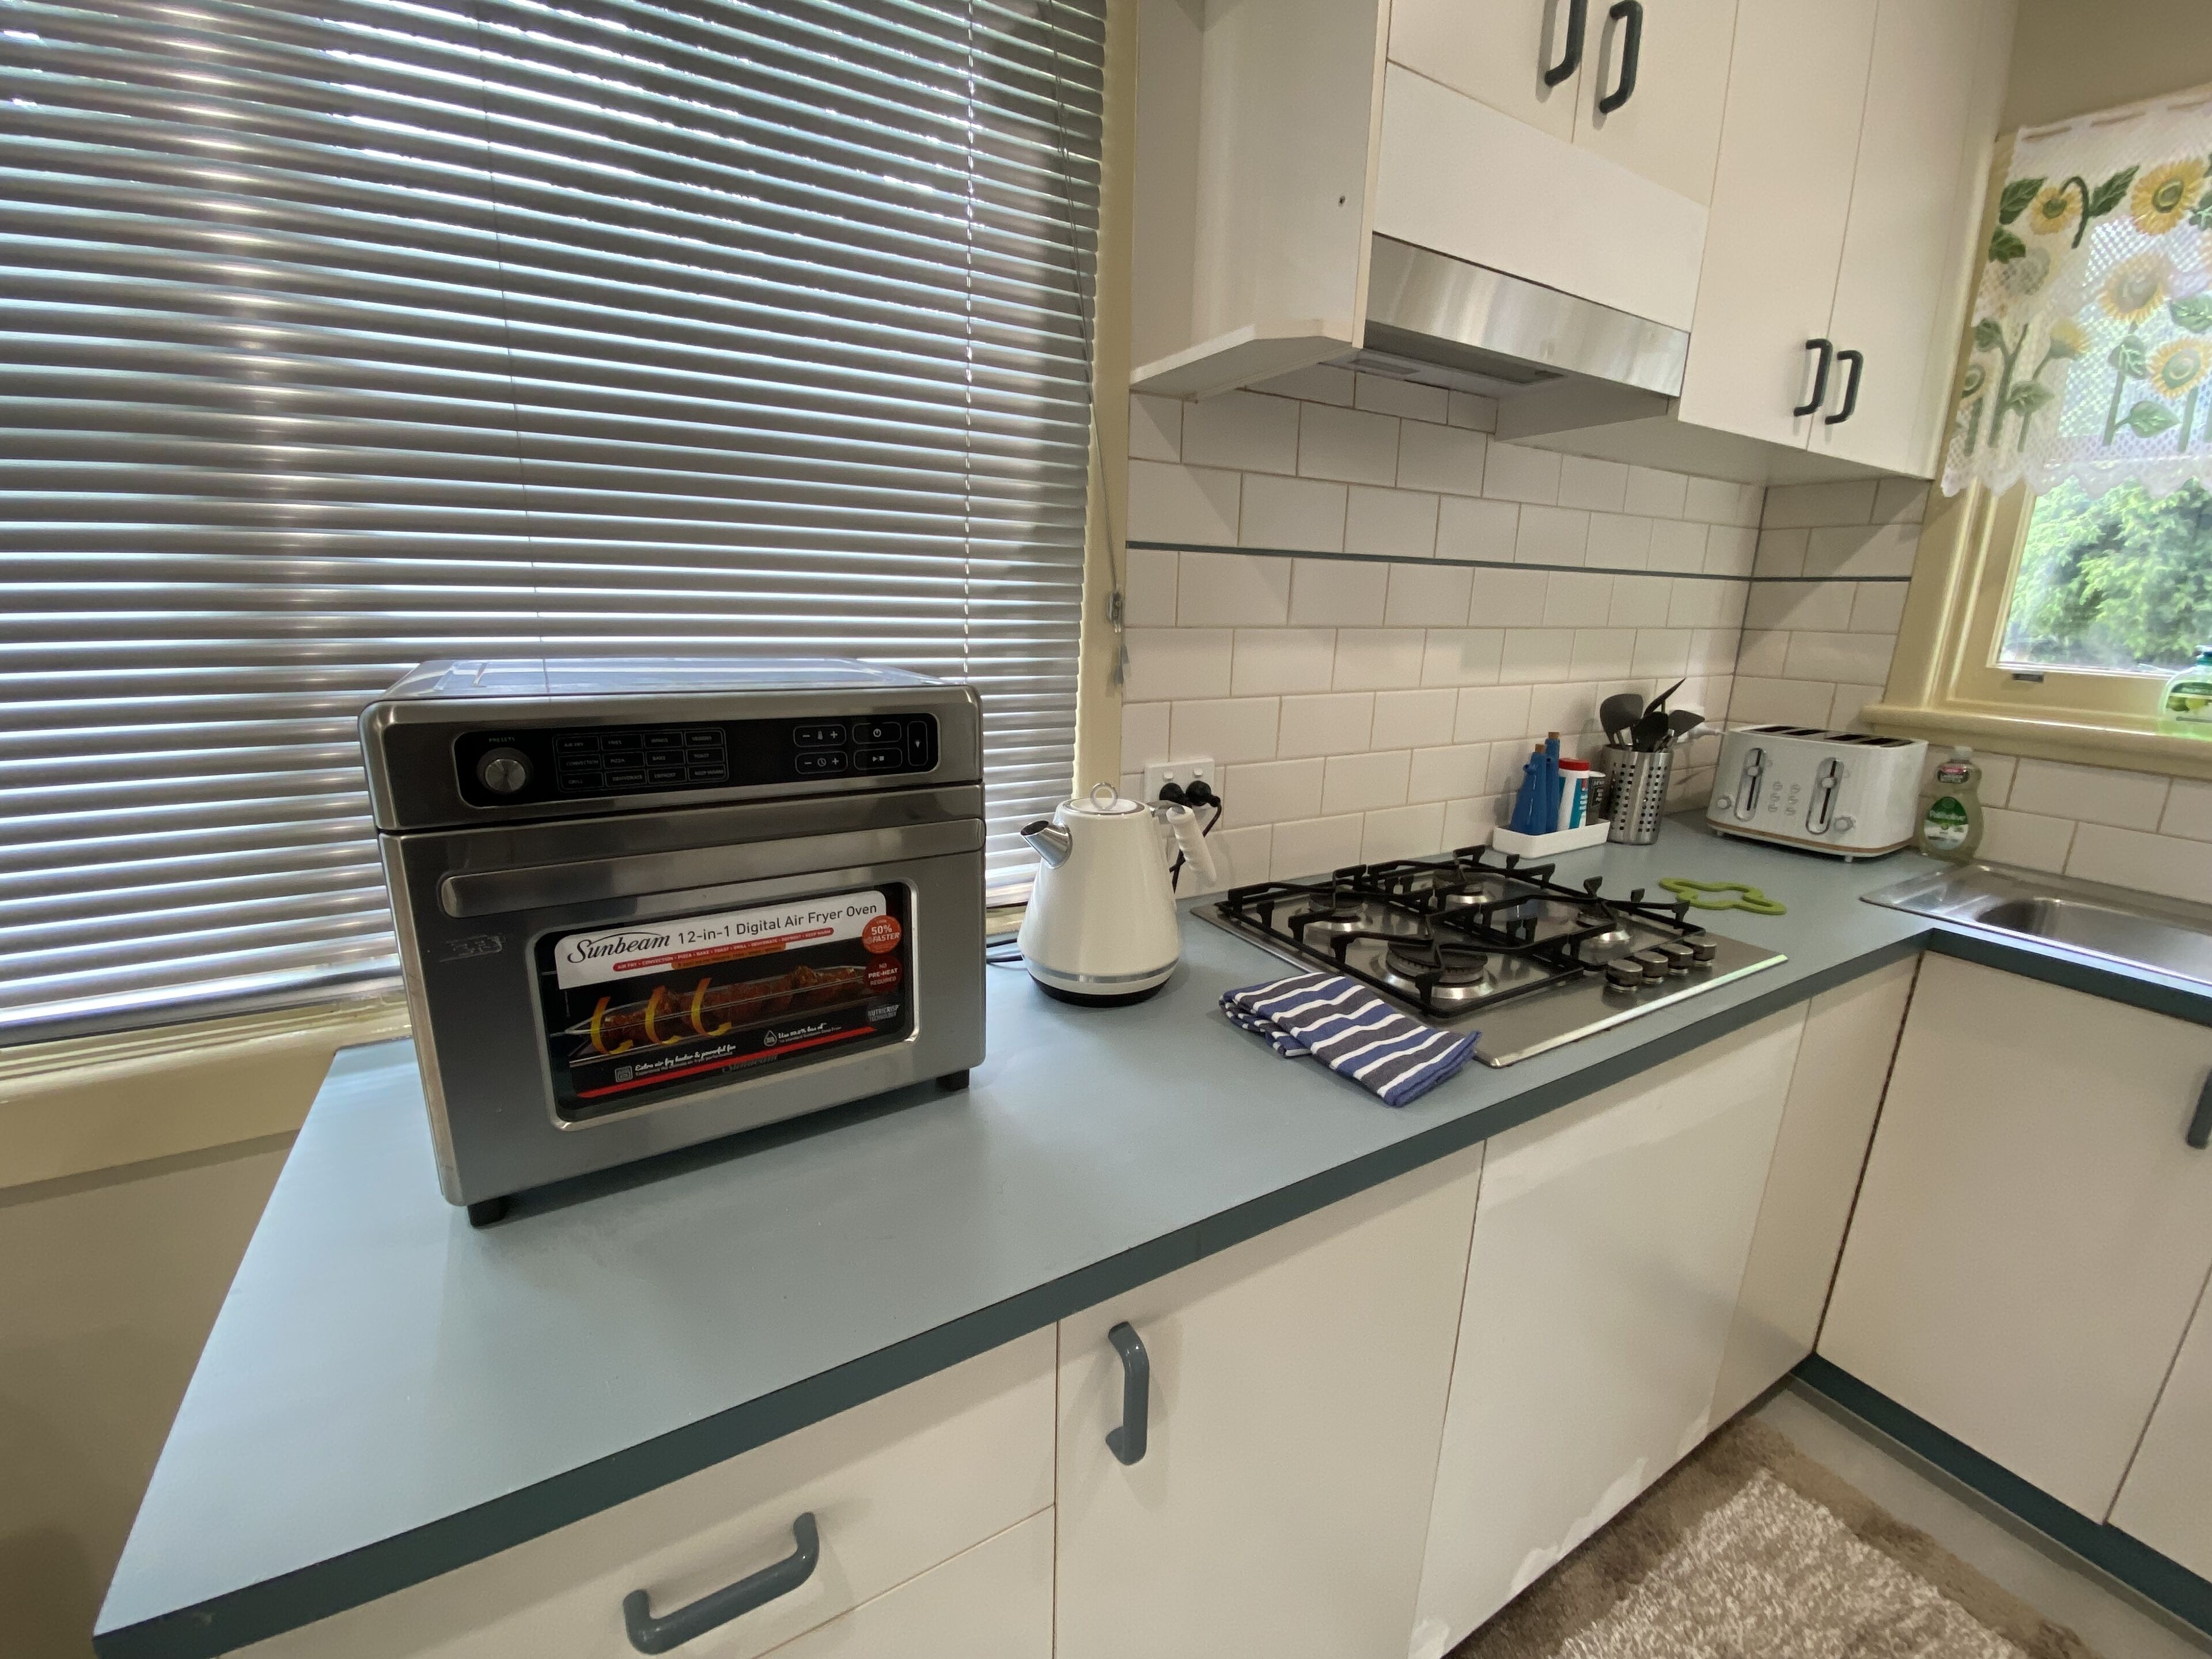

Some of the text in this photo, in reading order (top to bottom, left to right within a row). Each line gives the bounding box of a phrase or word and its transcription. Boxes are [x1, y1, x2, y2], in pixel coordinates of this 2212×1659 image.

[567, 905, 877, 963] Sunbeam 12-in-1 Digital Air Fryer Oven
[872, 924, 892, 935] 50%
[873, 932, 900, 943] FASTER
[868, 968, 898, 979] PRE-HEAT
[870, 976, 896, 986] REQUIRED
[635, 1063, 654, 1071] Extra
